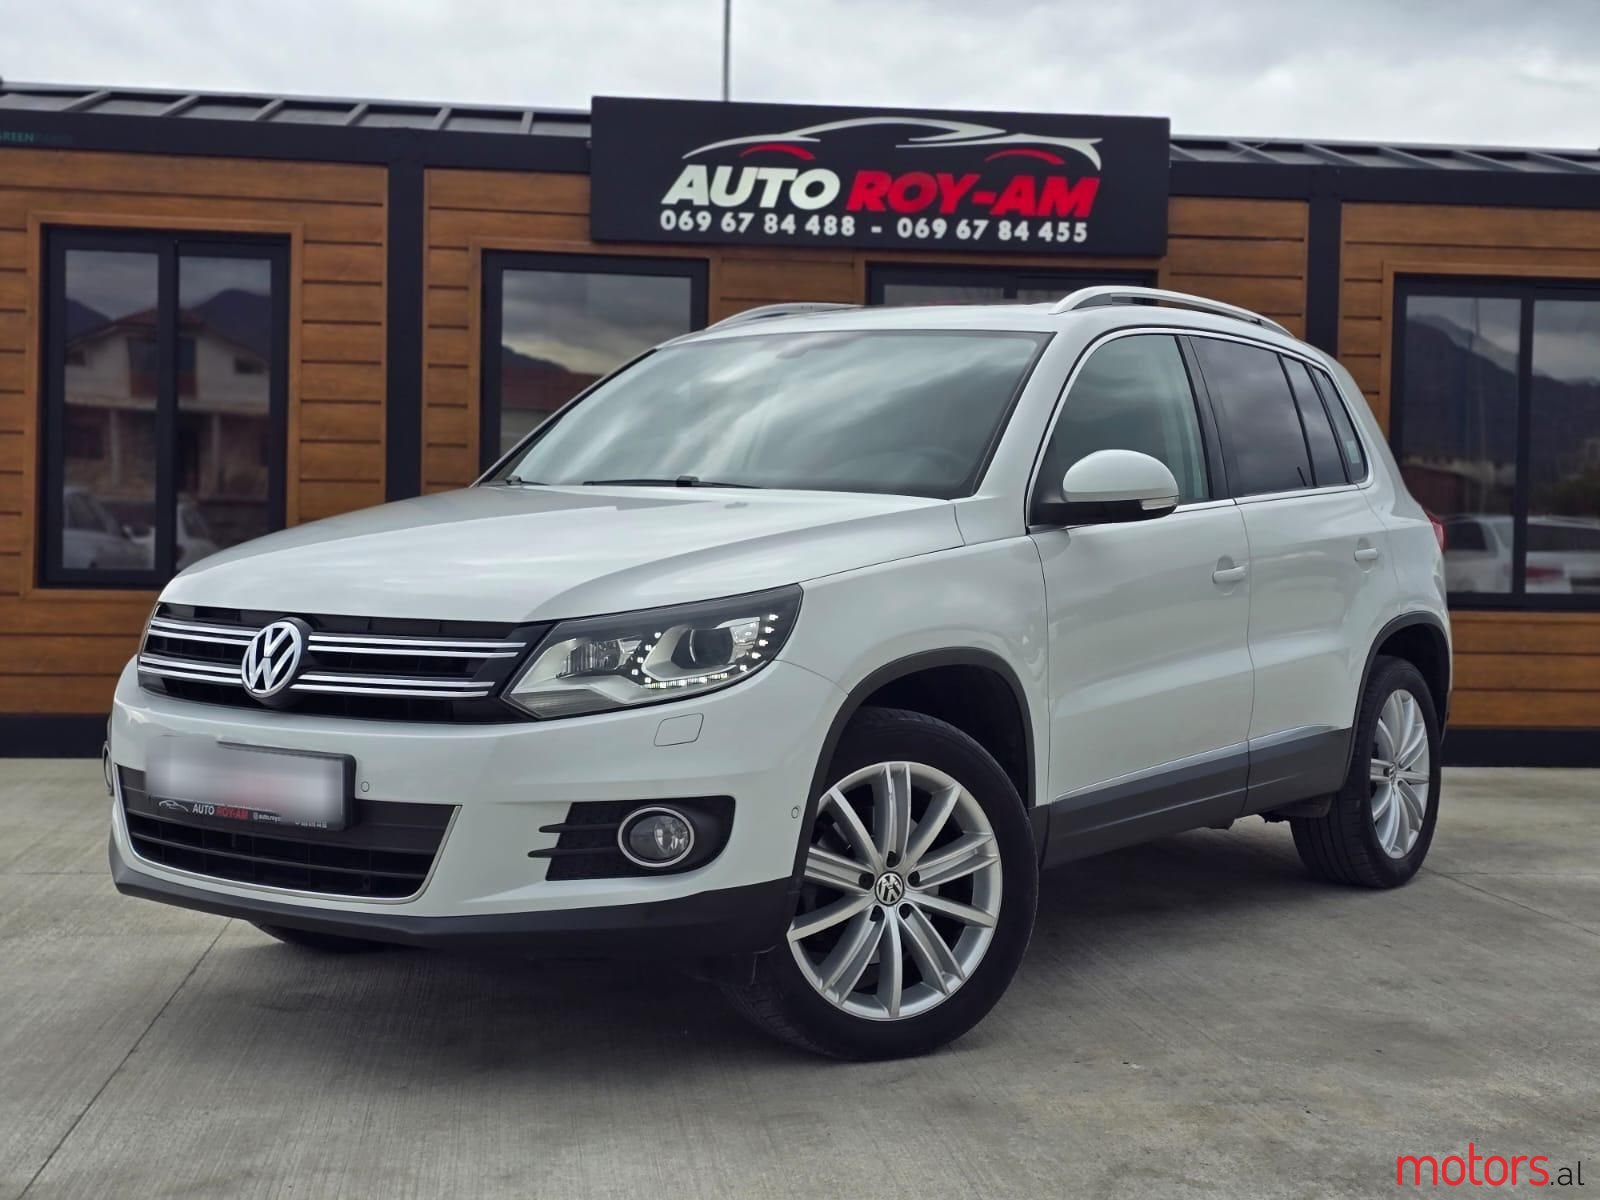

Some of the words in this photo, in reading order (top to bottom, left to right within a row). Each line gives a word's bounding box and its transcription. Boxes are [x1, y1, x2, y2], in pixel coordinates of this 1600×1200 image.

[661, 164, 841, 211] AUTO
[846, 170, 1100, 218] ROY-AM
[660, 209, 712, 232] 069
[720, 211, 755, 233] 67
[763, 212, 796, 235] 84
[804, 214, 855, 237] 488
[896, 217, 948, 239] 069
[955, 218, 989, 241] 67
[997, 219, 1030, 242] 84
[1037, 221, 1087, 243] 455
[192, 803, 215, 815] AUTO
